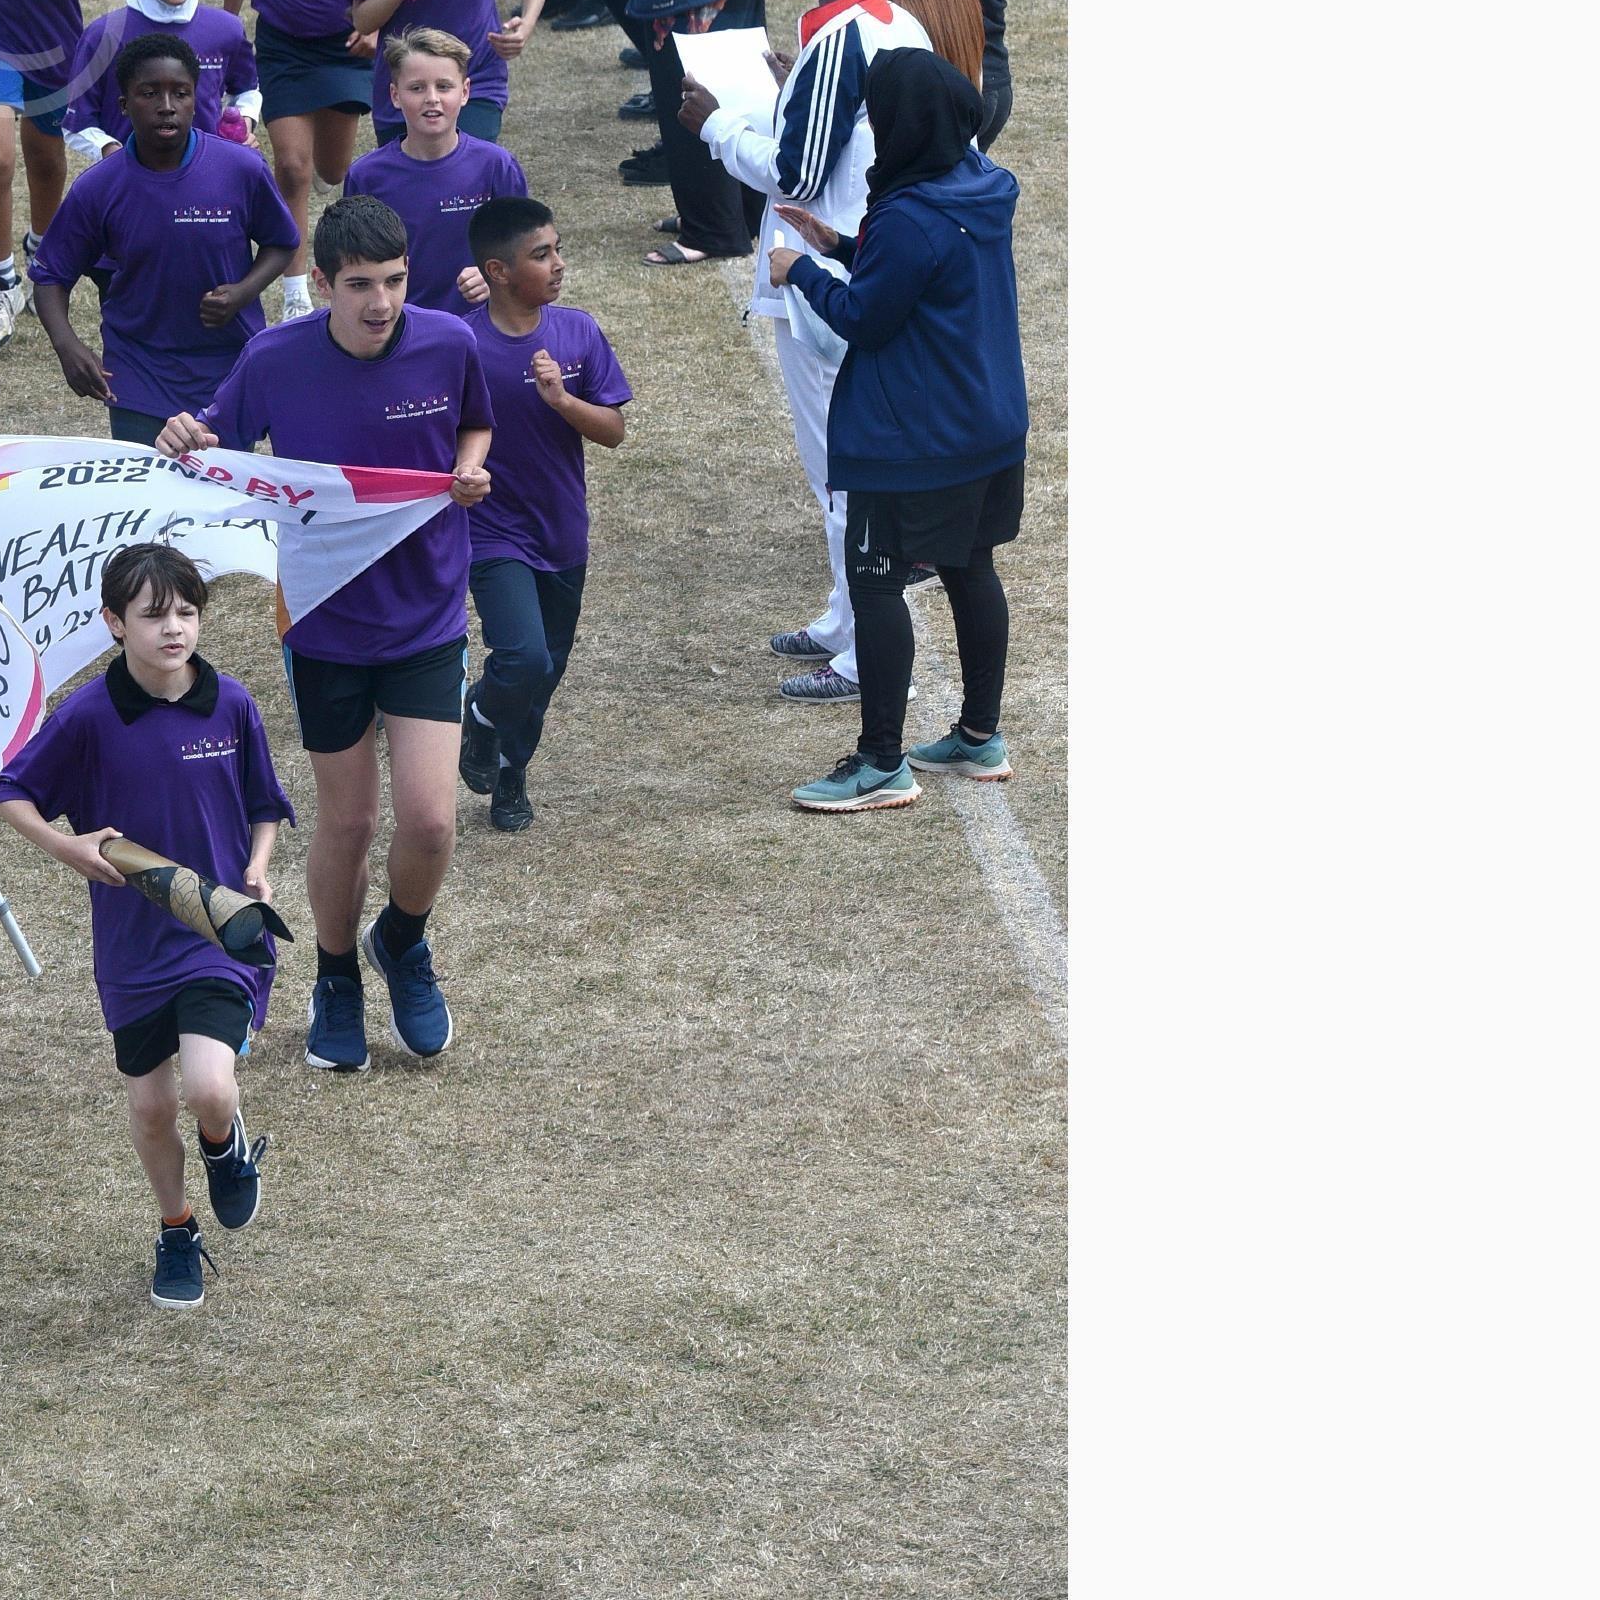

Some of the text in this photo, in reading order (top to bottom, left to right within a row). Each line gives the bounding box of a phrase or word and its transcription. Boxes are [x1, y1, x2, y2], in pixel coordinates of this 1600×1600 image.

[385, 397, 448, 412] SLOUGH
[39, 466, 150, 490] 2022
[246, 477, 314, 506] BY
